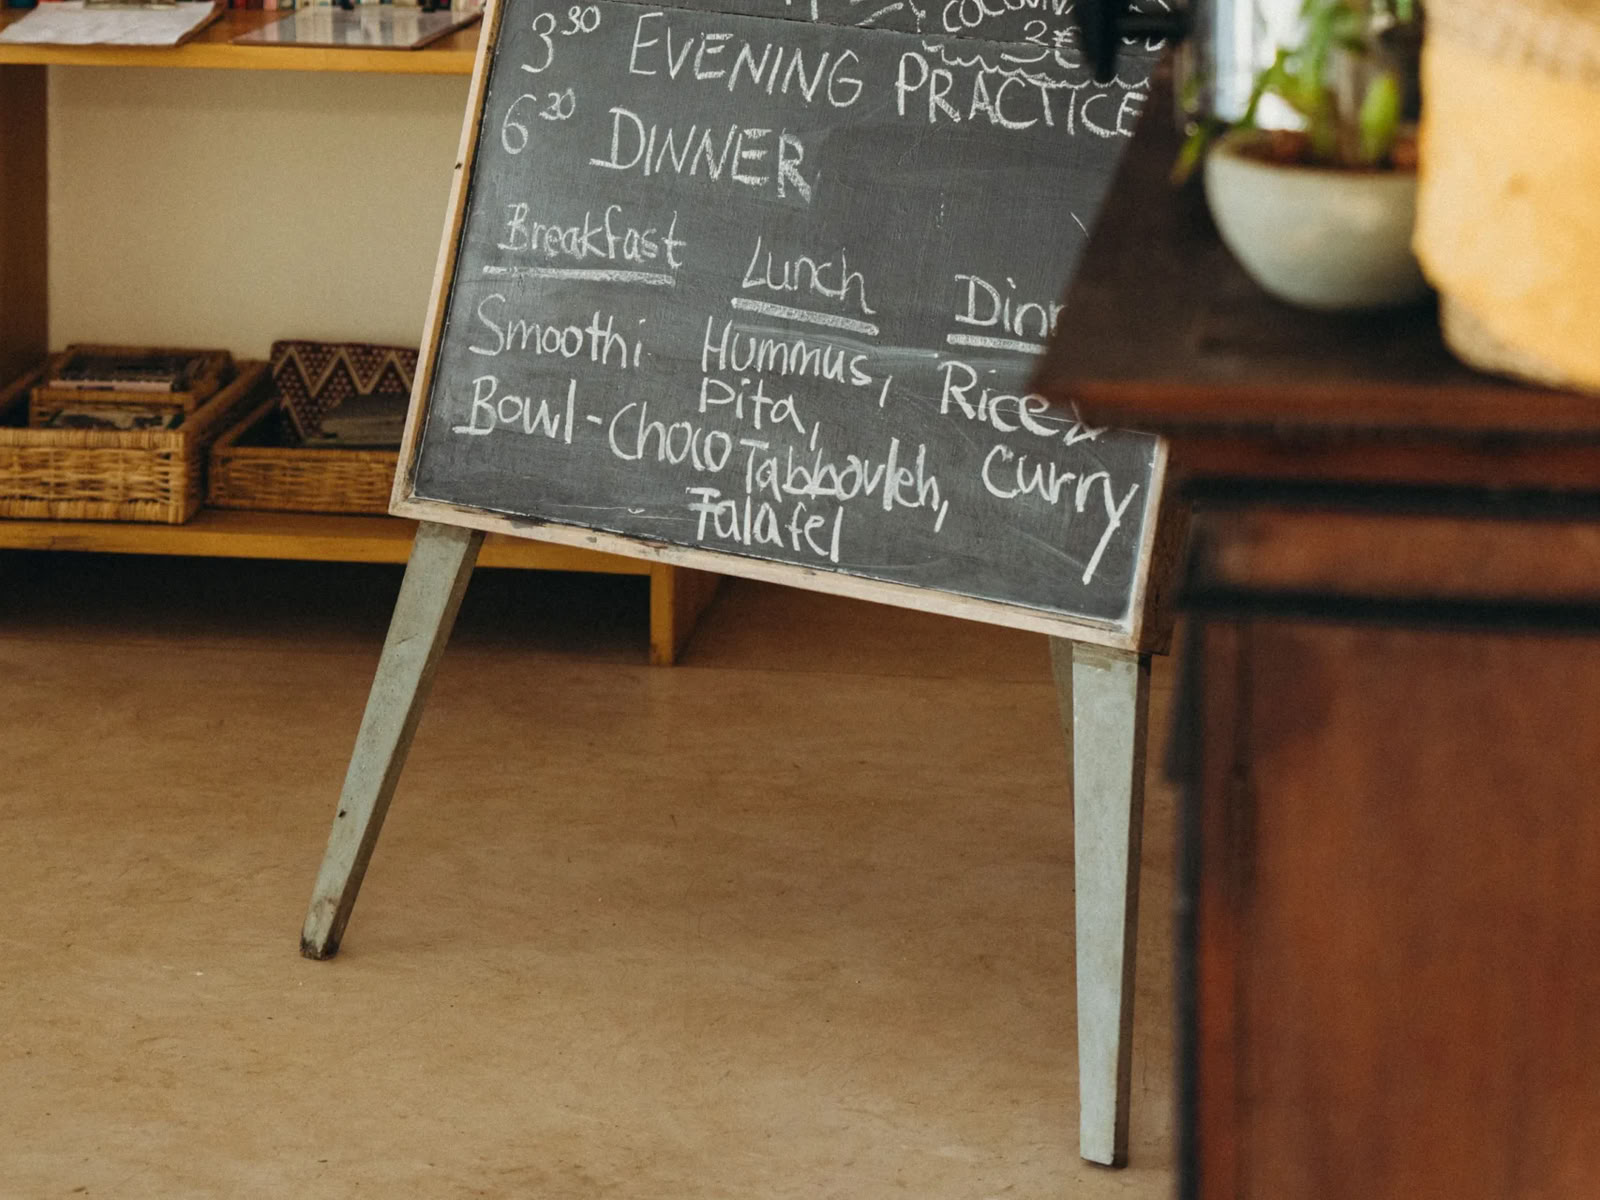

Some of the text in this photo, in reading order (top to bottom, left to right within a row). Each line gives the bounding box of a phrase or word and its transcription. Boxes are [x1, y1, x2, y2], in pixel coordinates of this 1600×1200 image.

[629, 11, 863, 108] EVENING
[895, 52, 1149, 138] PRACTICE
[588, 104, 811, 203] DINNER
[497, 202, 687, 270] Breakfast
[742, 236, 876, 315] Lunch
[468, 293, 647, 369] Smoothi
[937, 360, 1060, 437] Rice
[686, 487, 844, 563] Falafel
[981, 443, 1140, 585] Curry
